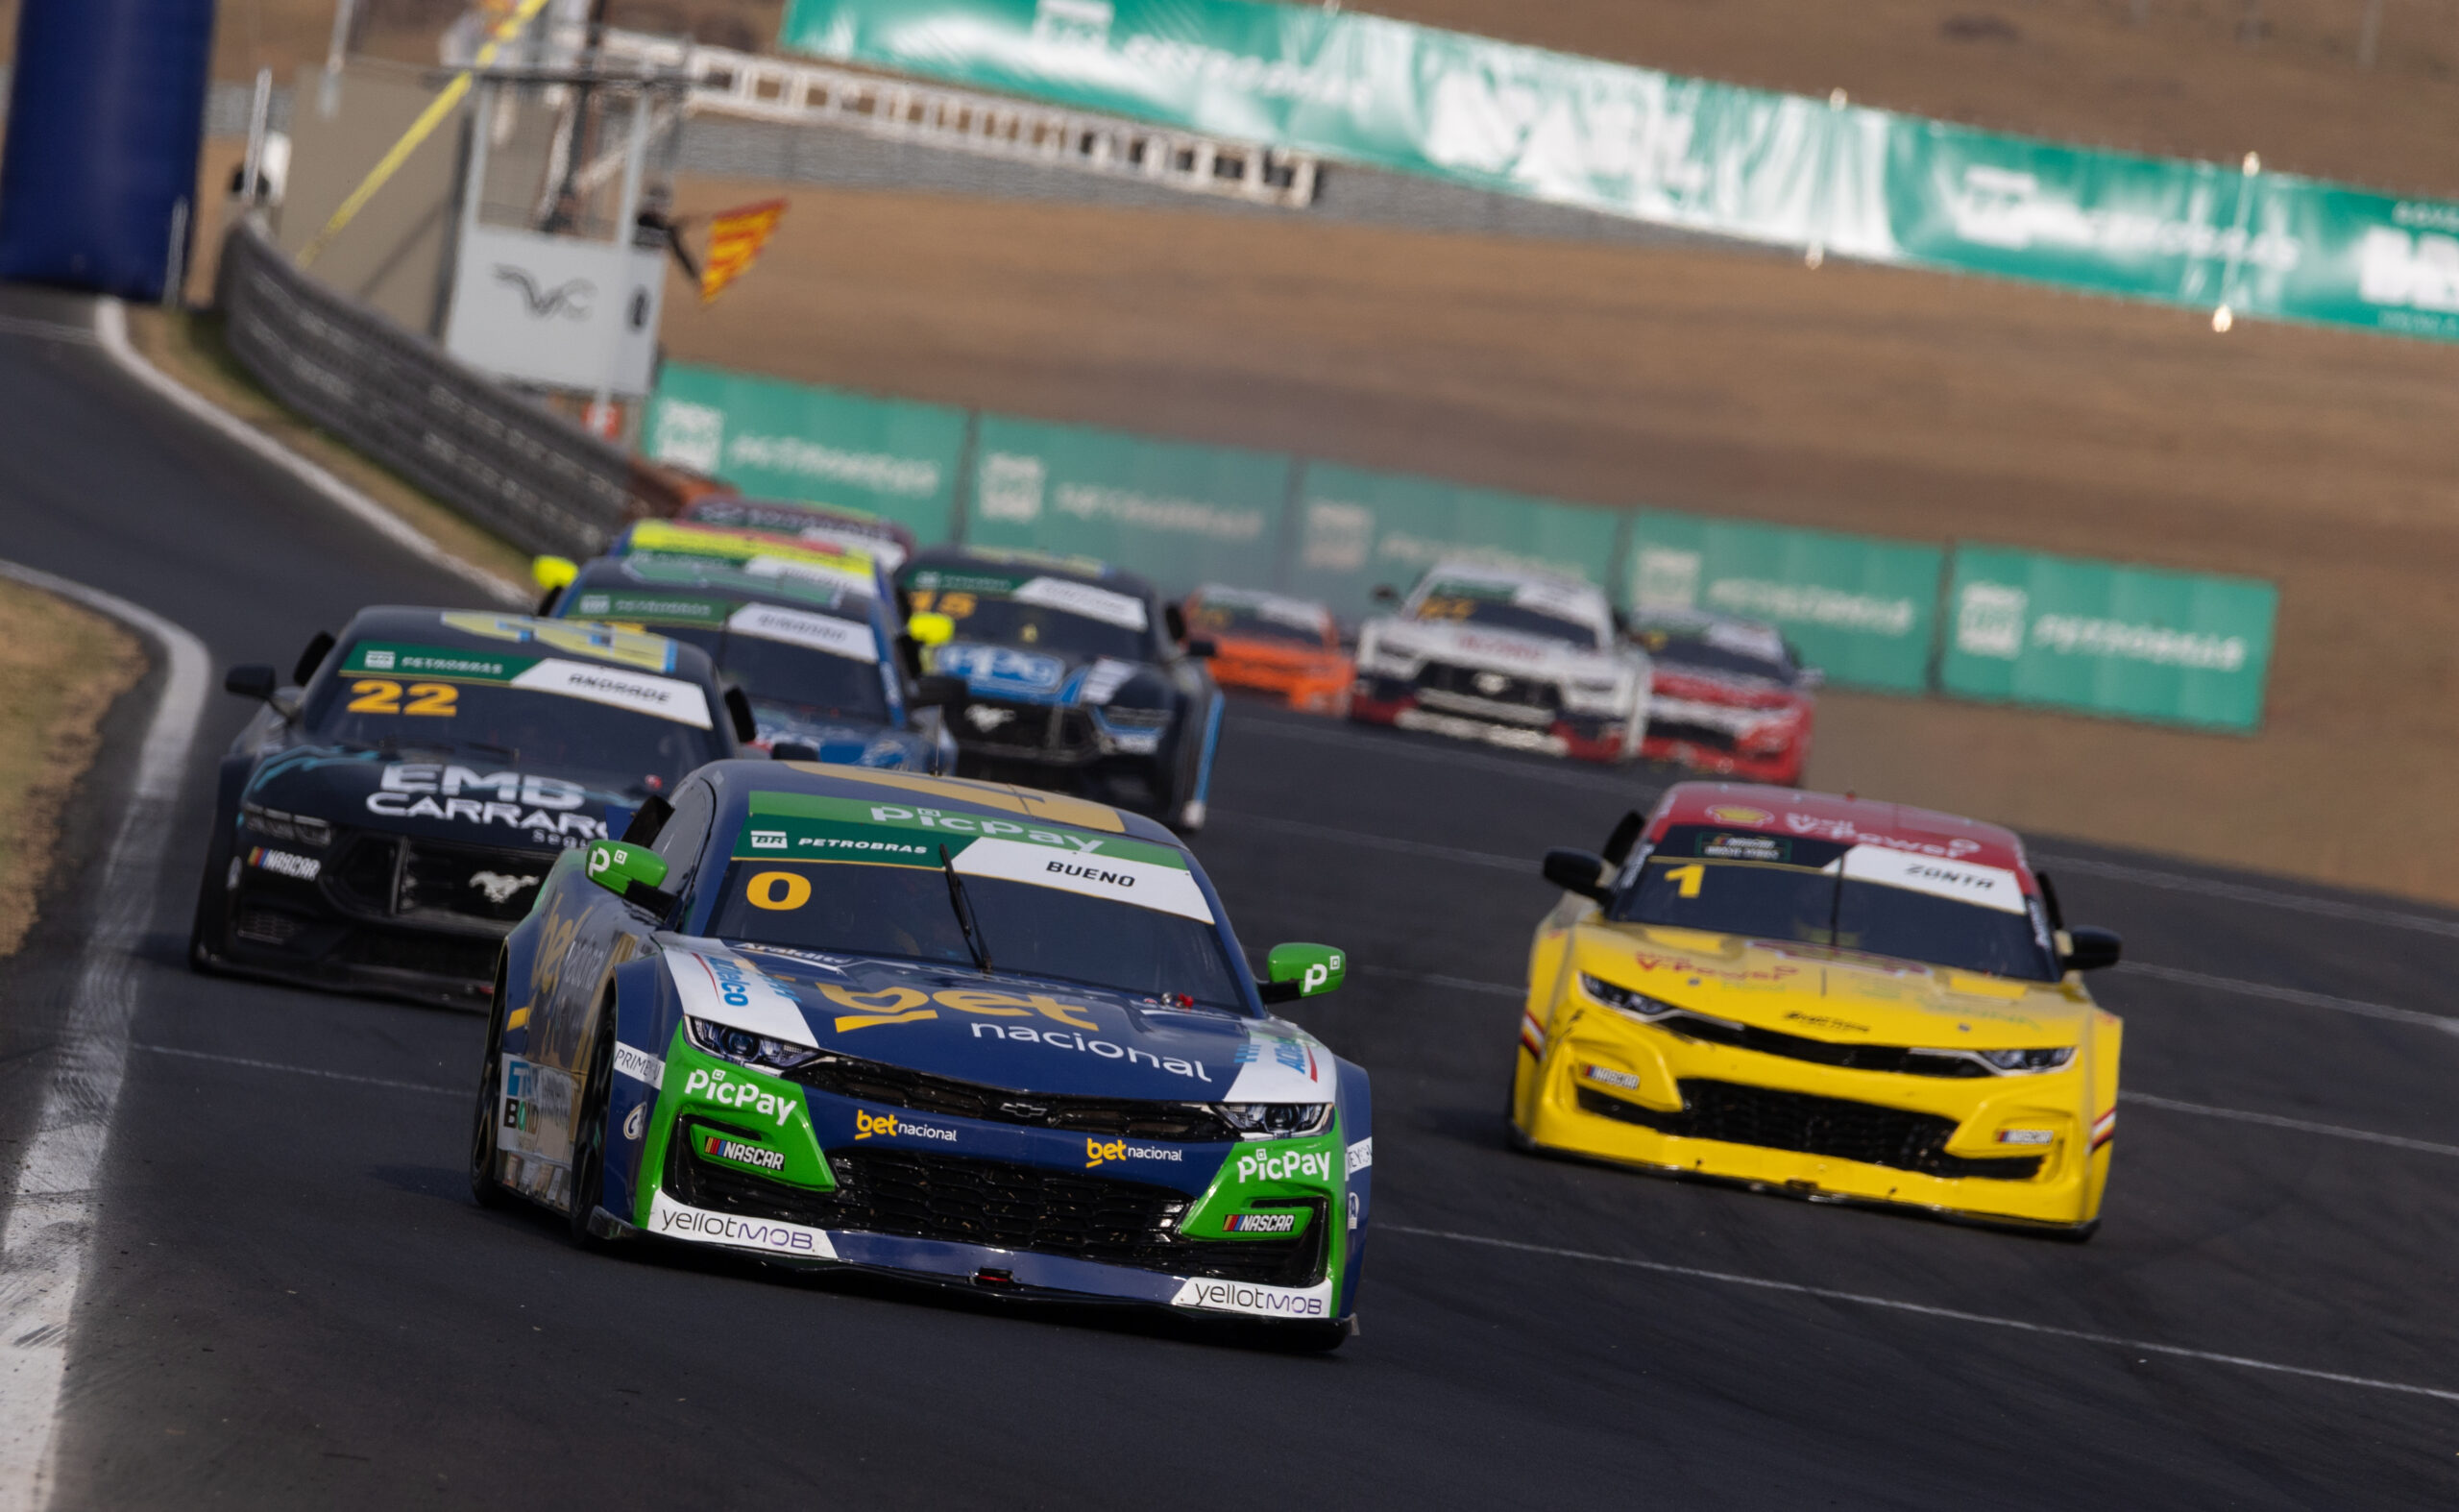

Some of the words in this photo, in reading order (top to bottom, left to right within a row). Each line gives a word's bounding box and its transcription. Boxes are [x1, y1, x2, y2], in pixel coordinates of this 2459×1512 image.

[347, 679, 459, 717] 22
[381, 764, 585, 810] EMB
[797, 838, 928, 855] PETROBRAS
[1045, 861, 1136, 888] BUENO
[1665, 865, 1706, 897] 1
[815, 982, 1099, 1033] bet
[971, 1022, 1212, 1083] nacional
[684, 1068, 797, 1126] PicPay
[722, 1140, 785, 1170] NASCAR
[1237, 1148, 1331, 1183] PicPay
[662, 1208, 813, 1250] yellotMOB
[1239, 1214, 1295, 1232] NASCAR
[1195, 1283, 1323, 1315] yellotMOB
